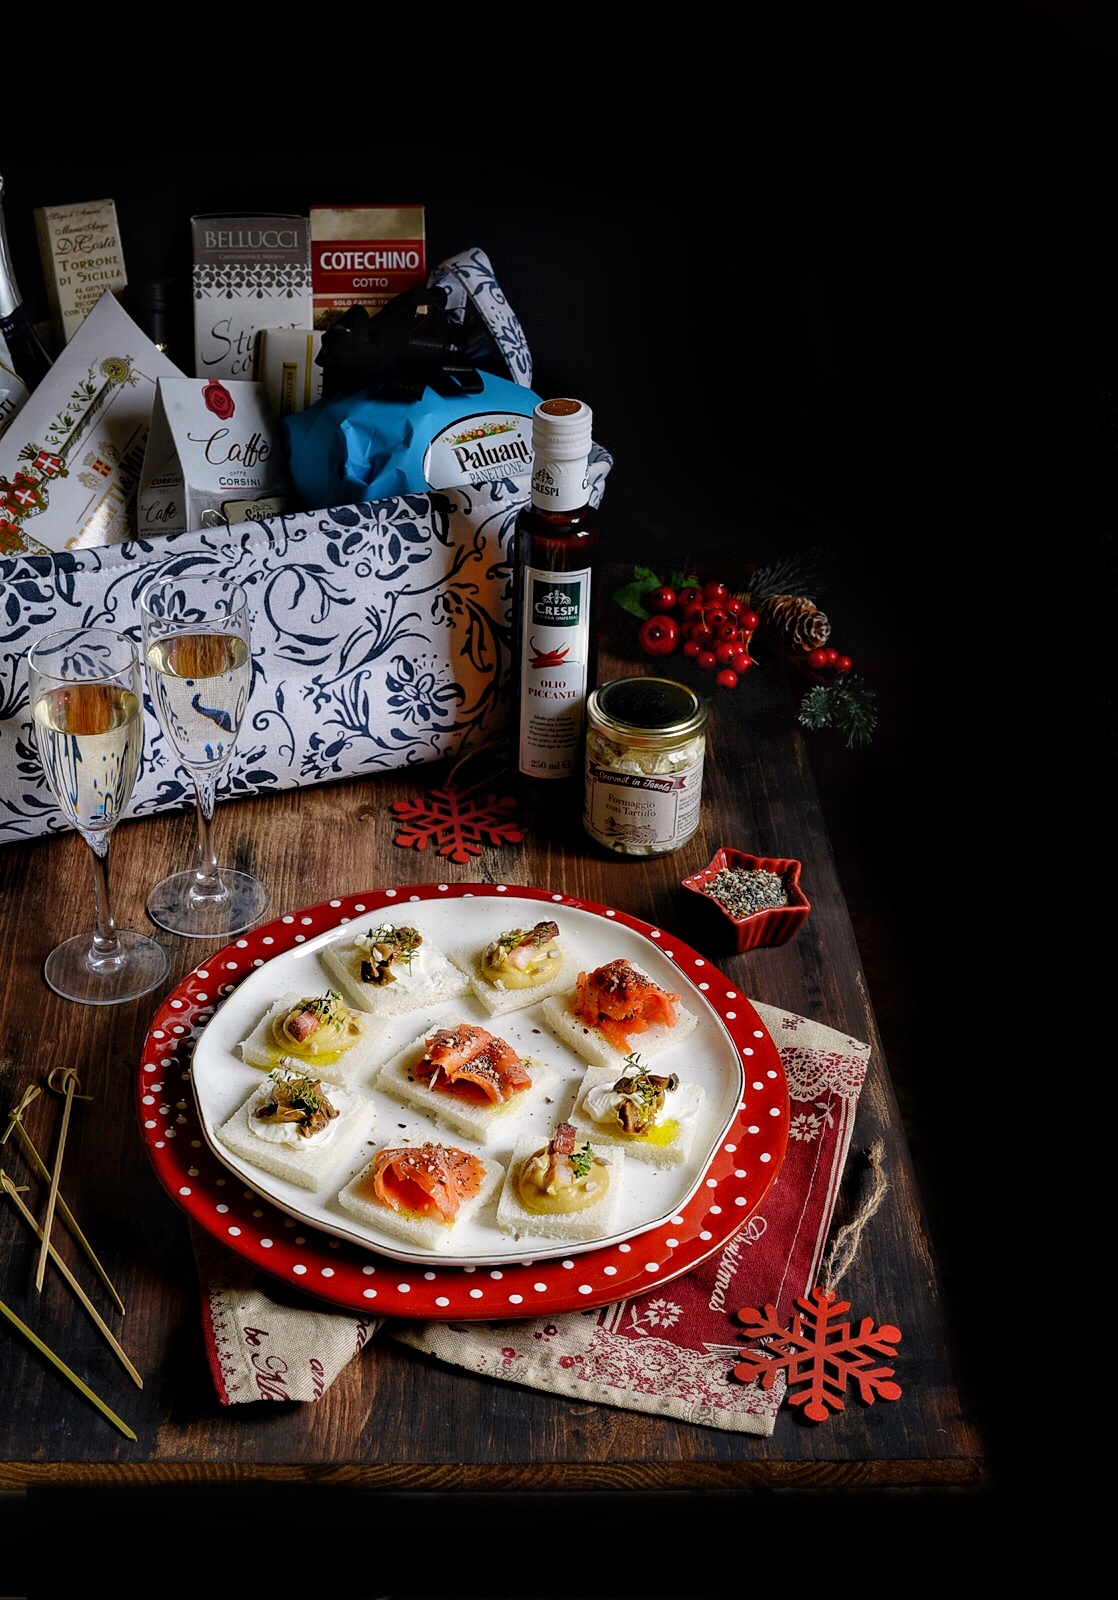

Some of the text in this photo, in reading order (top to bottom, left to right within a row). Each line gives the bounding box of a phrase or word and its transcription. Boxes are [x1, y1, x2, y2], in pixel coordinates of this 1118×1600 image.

[204, 230, 299, 248] BELLUCCI
[59, 256, 119, 271] TORRONE
[320, 251, 420, 270] COTECHINO
[77, 270, 123, 283] SICILIA
[352, 277, 389, 288] COTTO
[201, 317, 258, 366] Sti
[187, 428, 272, 468] Caffè
[451, 433, 533, 473] Paluani
[469, 461, 525, 485] PANETTONE
[151, 477, 182, 486] CORSINI
[219, 477, 261, 486] CORSINI
[532, 477, 559, 497] CRESPI
[141, 500, 177, 523] Caffè
[535, 602, 579, 616] CRESPI
[540, 680, 566, 689] OLIO
[528, 687, 579, 700] PICCANTE
[531, 760, 547, 769] 250
[548, 761, 560, 770] ml
[631, 777, 640, 786] in
[643, 778, 671, 792] Tavola
[608, 793, 656, 810] Formaggio
[605, 803, 656, 817] con Tartufo
